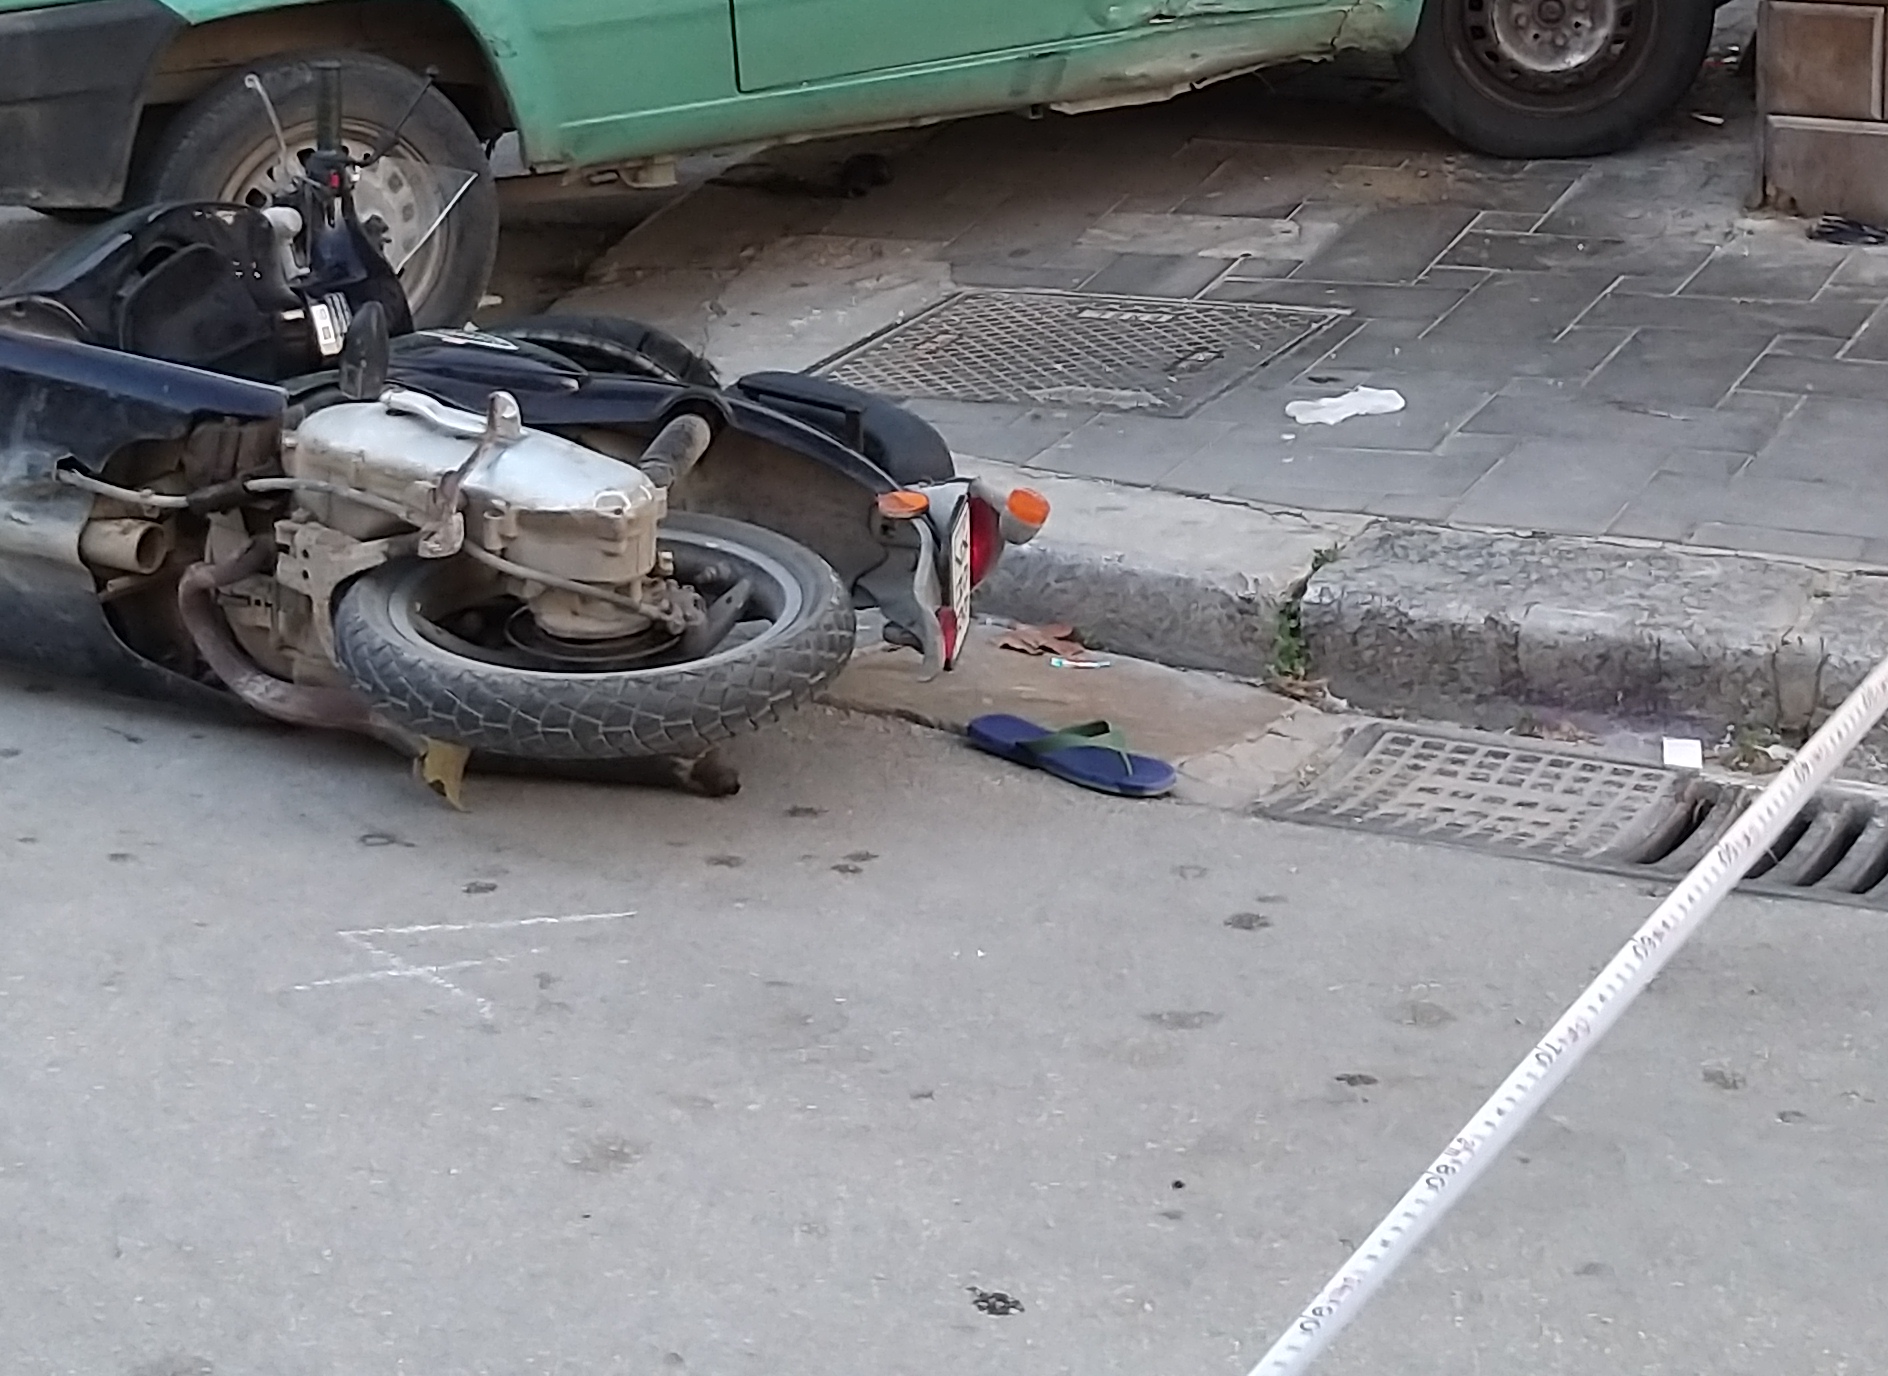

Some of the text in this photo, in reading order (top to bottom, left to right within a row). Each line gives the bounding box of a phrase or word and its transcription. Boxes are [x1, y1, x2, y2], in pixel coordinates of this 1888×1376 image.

[1534, 1041, 1563, 1068] 70
[1425, 1163, 1457, 1194] 80
[1299, 1305, 1334, 1335] 90
